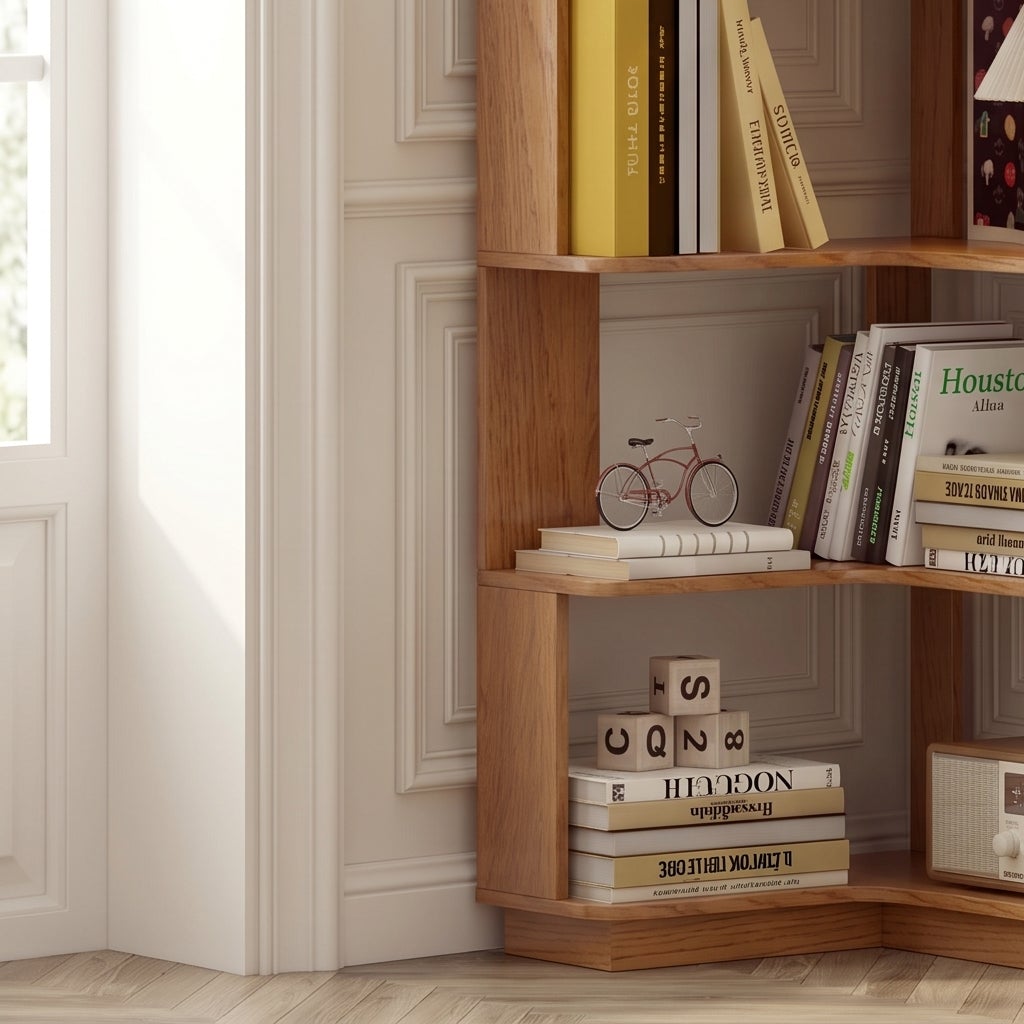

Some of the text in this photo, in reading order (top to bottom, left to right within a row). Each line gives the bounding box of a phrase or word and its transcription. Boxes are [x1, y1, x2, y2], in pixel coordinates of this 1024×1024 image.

[680, 674, 711, 701] S
[604, 726, 630, 756] C
[646, 724, 667, 758] Q
[683, 729, 709, 753] 2
[724, 727, 744, 751] 8
